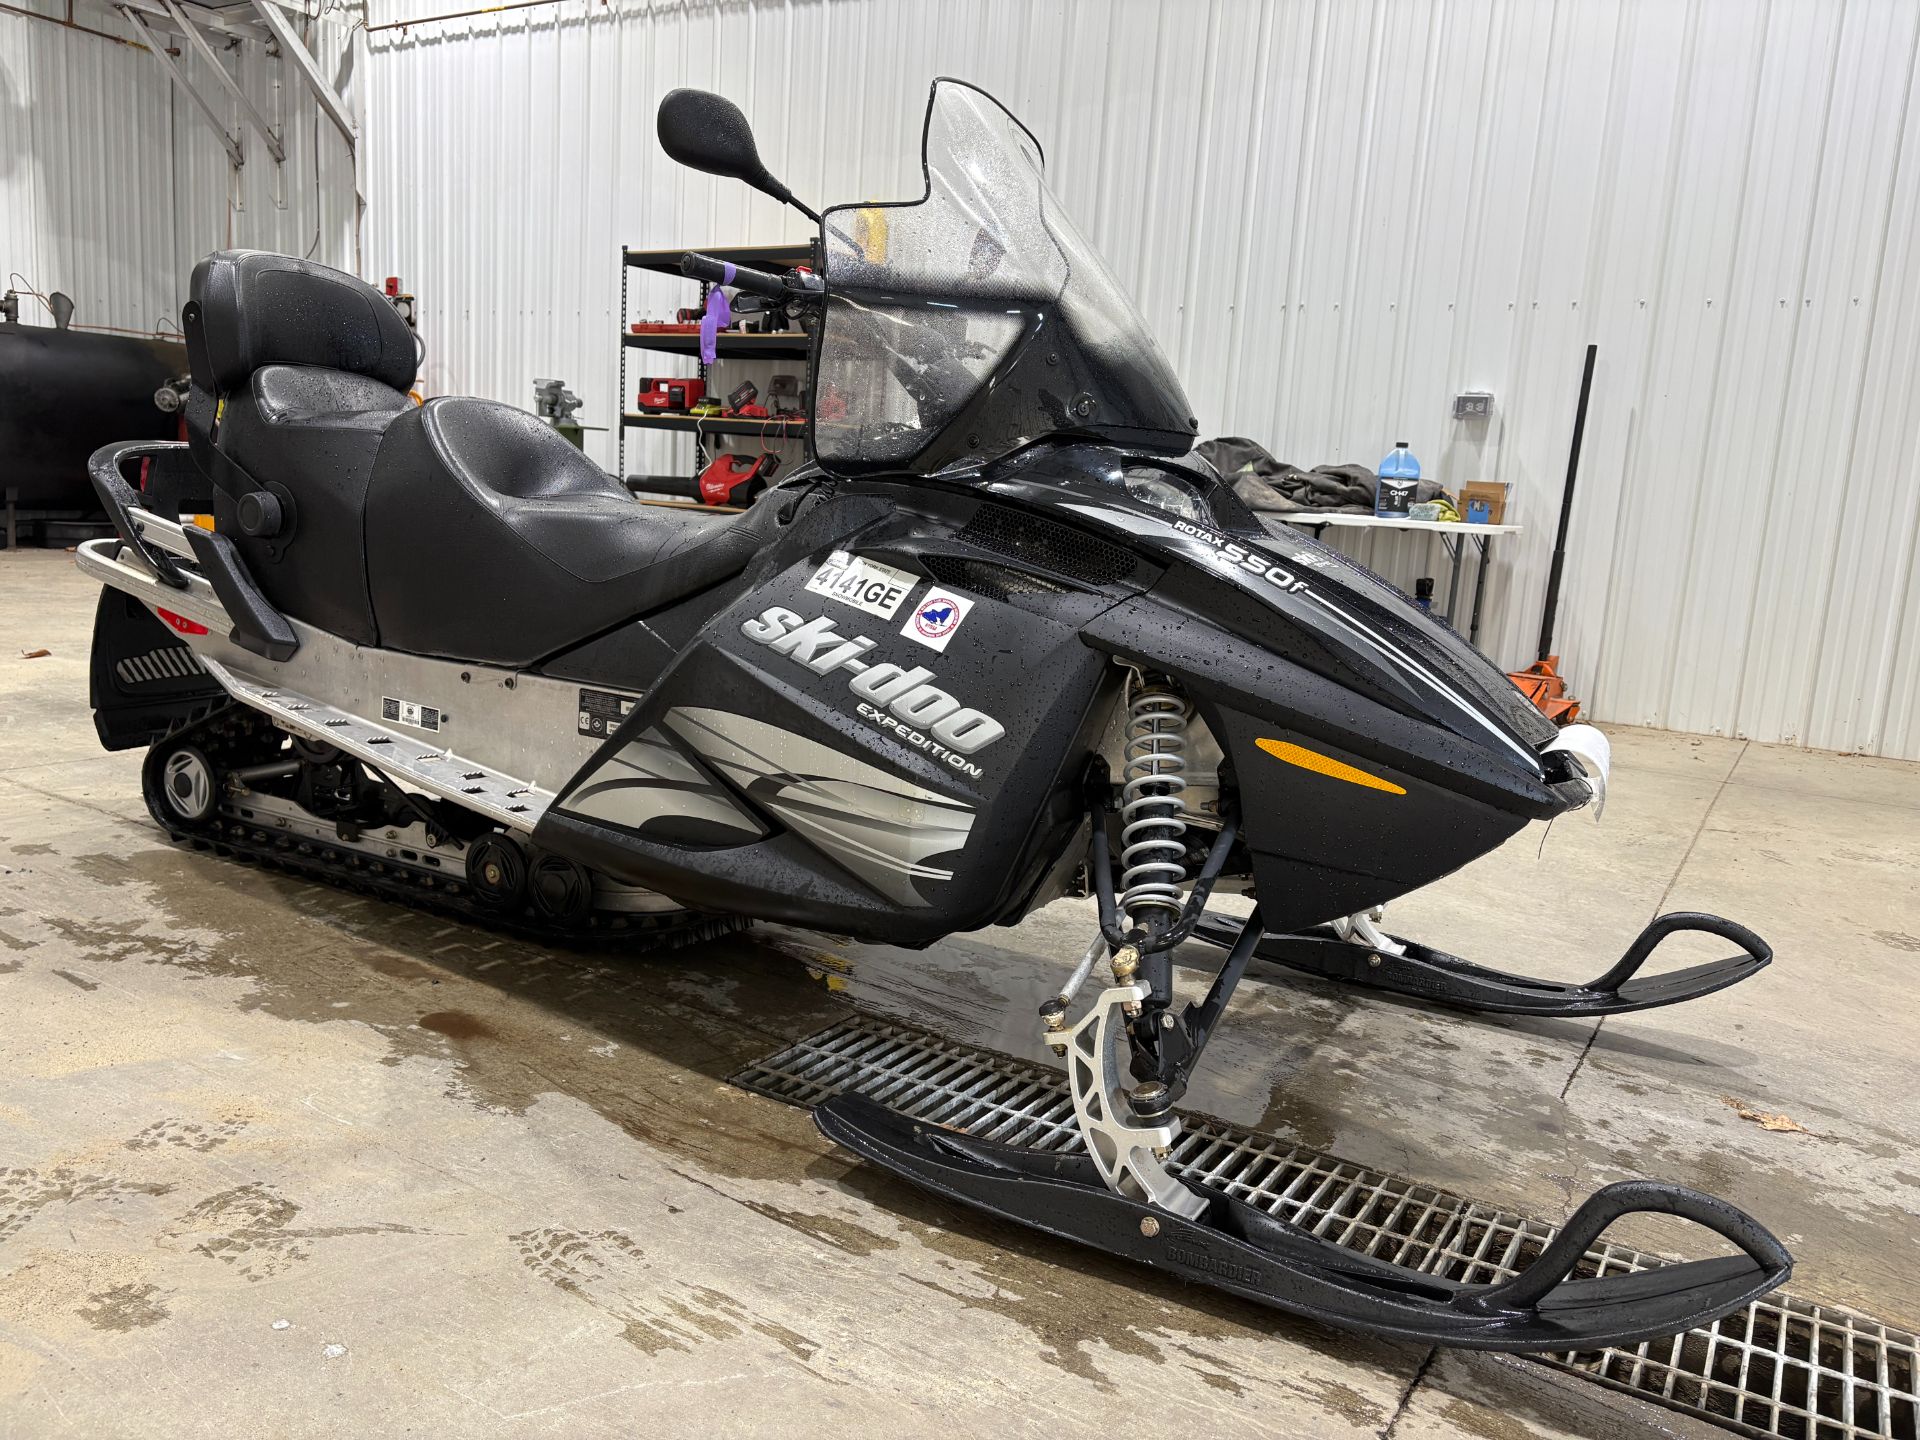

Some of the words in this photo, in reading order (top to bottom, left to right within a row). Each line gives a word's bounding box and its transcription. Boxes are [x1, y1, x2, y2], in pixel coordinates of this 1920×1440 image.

[1173, 520, 1225, 547] ROTAX
[815, 567, 902, 610] 4141GE
[832, 591, 863, 607] SNOWMOBILE
[856, 702, 985, 779] EXPEDITION
[1167, 1246, 1263, 1286] BOMBARDIER
